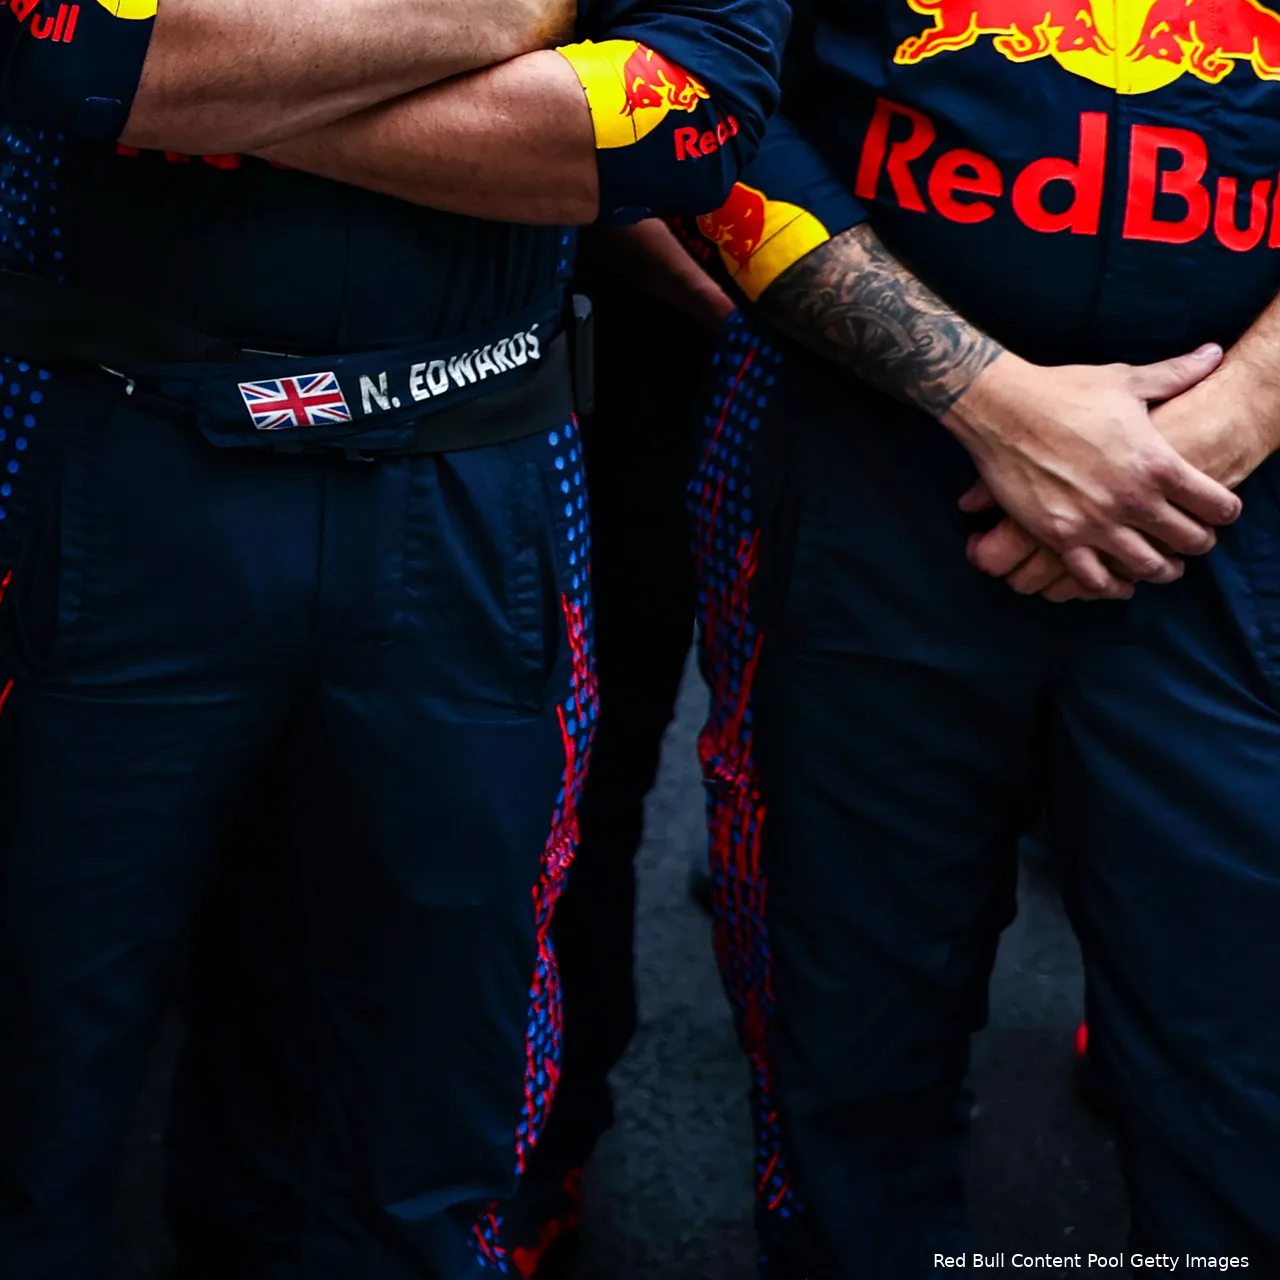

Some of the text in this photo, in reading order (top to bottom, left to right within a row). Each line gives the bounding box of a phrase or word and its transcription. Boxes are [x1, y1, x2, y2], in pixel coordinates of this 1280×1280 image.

[30, 2, 80, 44] ull
[854, 96, 1280, 253] Red Bu
[359, 323, 541, 415] N. EDWARDS
